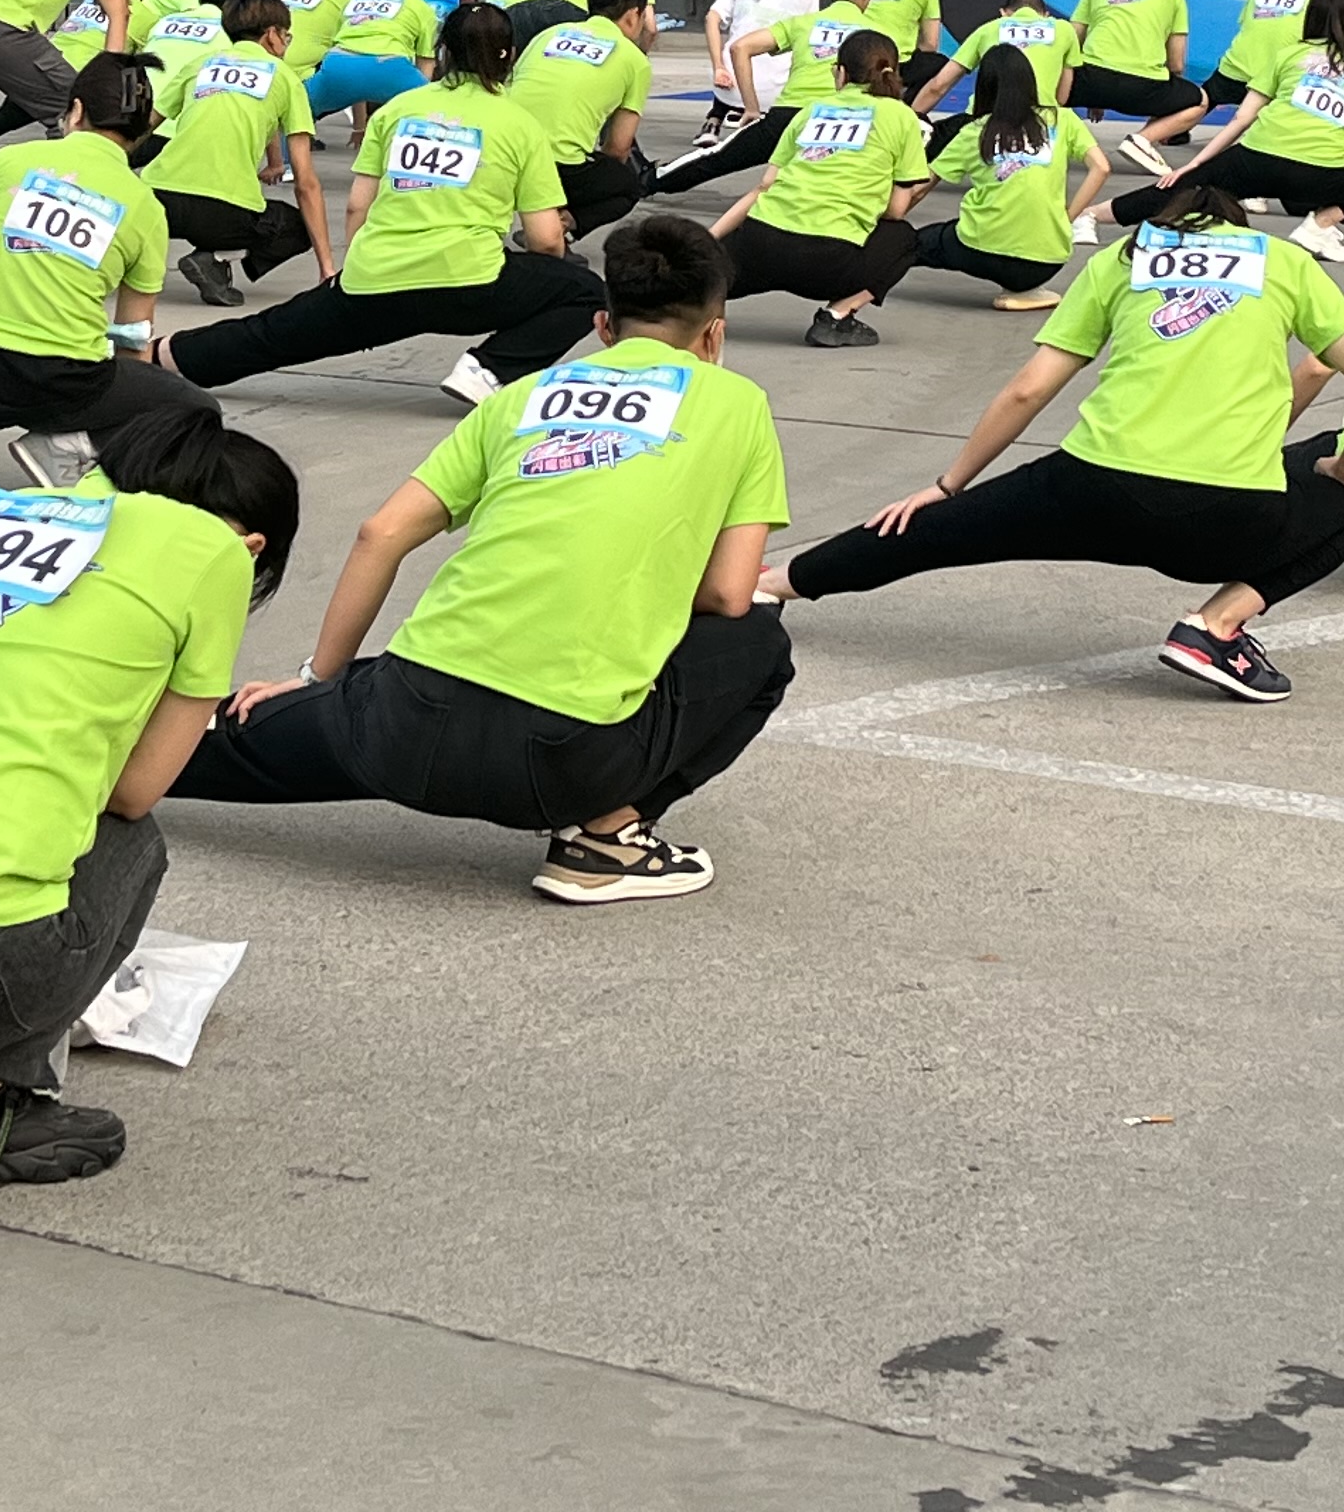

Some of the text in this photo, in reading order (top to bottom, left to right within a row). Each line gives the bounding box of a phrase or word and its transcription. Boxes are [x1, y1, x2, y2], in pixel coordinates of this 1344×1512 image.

[164, 21, 208, 38] 049
[819, 29, 844, 44] 11
[1007, 26, 1046, 40] 113
[555, 38, 603, 62] 043
[208, 65, 260, 90] 103
[1303, 88, 1344, 120] 100
[812, 121, 861, 144] 111
[400, 142, 464, 178] 042
[25, 200, 97, 249] 106
[1148, 252, 1242, 280] 087
[539, 388, 652, 423] 096
